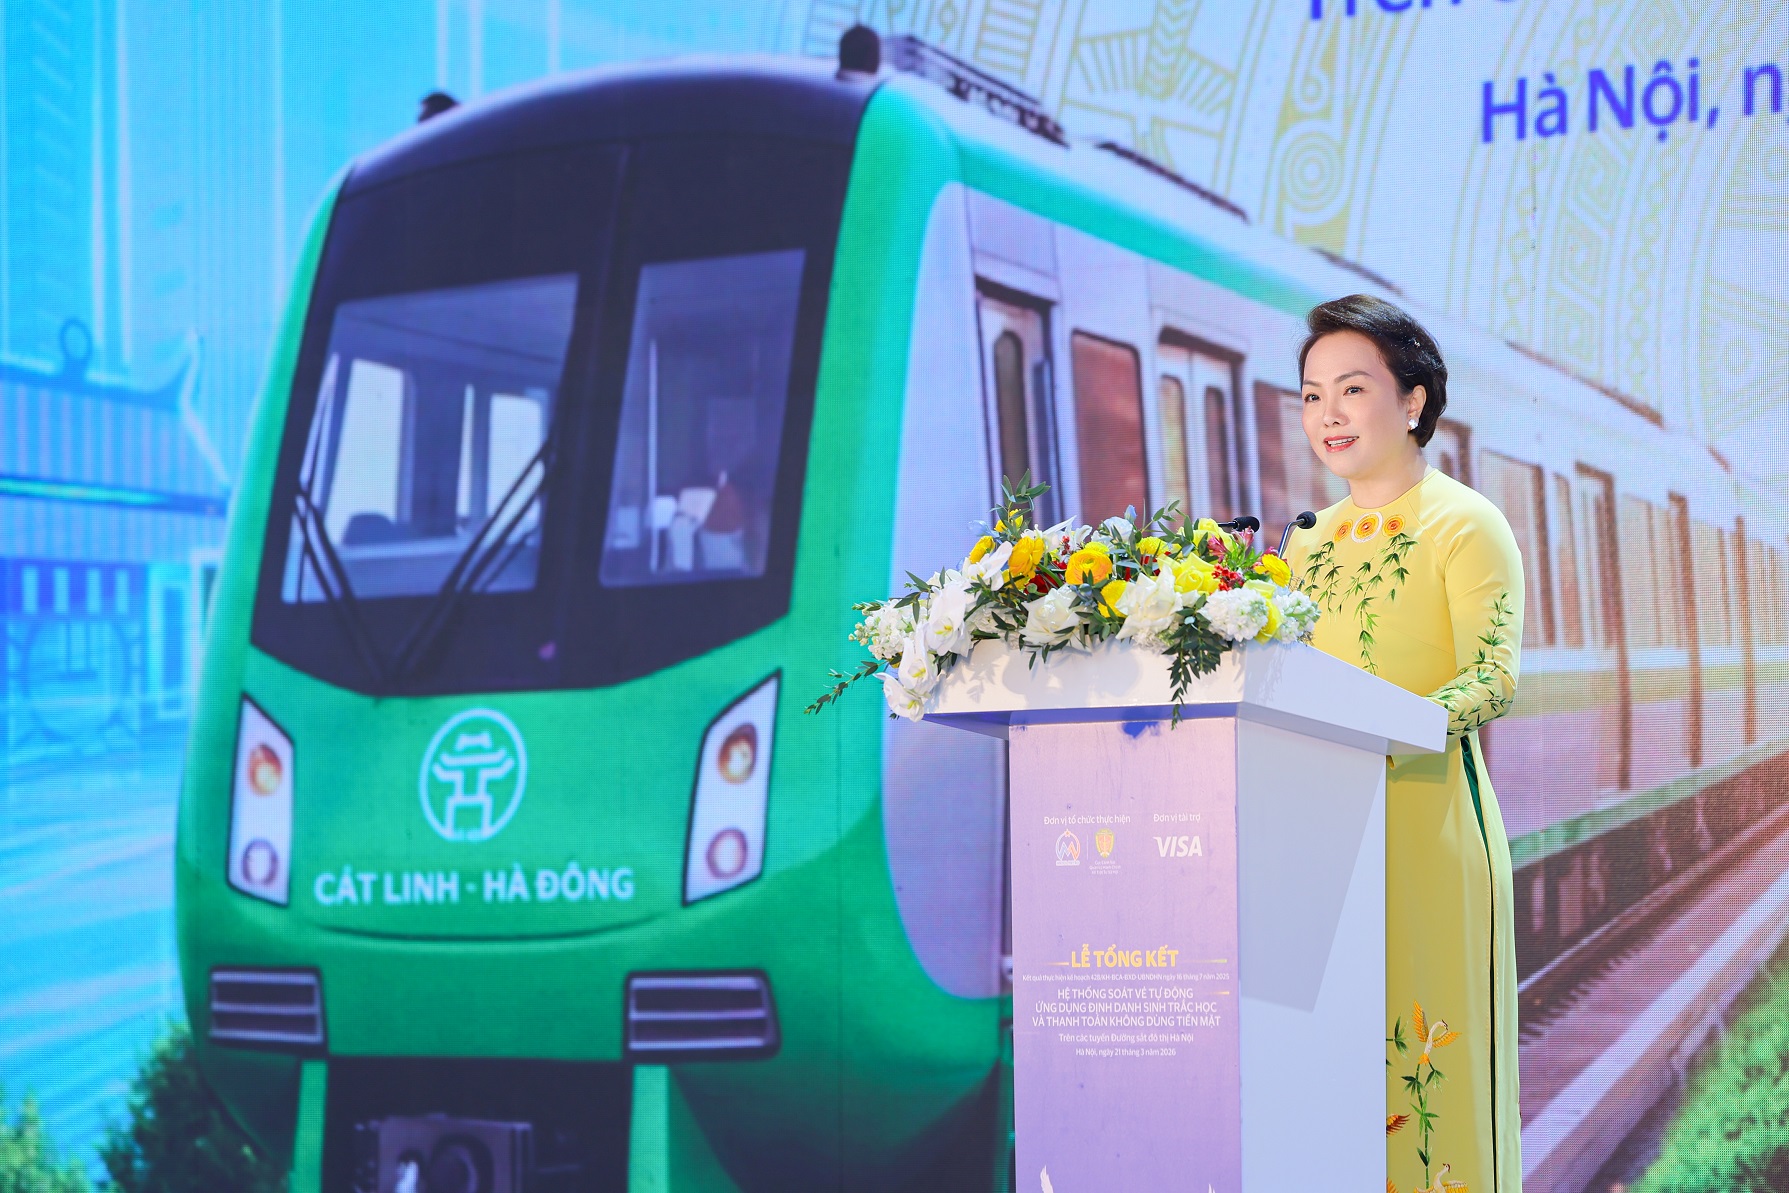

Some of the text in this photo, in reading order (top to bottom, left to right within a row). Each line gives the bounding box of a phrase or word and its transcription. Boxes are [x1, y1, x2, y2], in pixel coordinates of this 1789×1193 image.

[1481, 73, 1568, 143] Hà
[1587, 58, 1719, 142] Nội,
[1044, 816, 1059, 825] Đơn
[1061, 816, 1067, 826] vị
[1077, 815, 1095, 825] chức
[1096, 815, 1112, 825] thực
[1114, 814, 1131, 825] hiện
[1153, 812, 1201, 824] Đơn vị tài trợ
[1152, 835, 1203, 858] VISA
[313, 864, 377, 905] CÁT
[383, 871, 460, 904] LINH
[483, 862, 530, 902] HÀ
[534, 861, 635, 901] ĐÔNG
[1071, 943, 1179, 968] LỄ TỔNG KẾT
[1183, 972, 1199, 982] tháng
[1057, 985, 1194, 1001] HỆ THỐNG SOÁT VÉ TỰ ĐỘNG
[1035, 999, 1218, 1015] ỨNG DỤNG ĐỊNH DANH SINH TRẮC HỌC
[1032, 1013, 1222, 1029] VÀ THANH TOÁN KHÔNG DÙNG TIỀN MẶT
[1058, 1033, 1075, 1042] Trên
[1075, 1033, 1088, 1042] các
[1089, 1033, 1110, 1044] tuyến
[1110, 1033, 1136, 1044] Đường
[1147, 1033, 1158, 1042] đô
[1158, 1033, 1170, 1044] thị
[1169, 1033, 1181, 1042] Hà
[1181, 1032, 1194, 1044] Nội
[1075, 1047, 1176, 1058] Hà Nội, ngày 21 tháng 3 năm 2026
